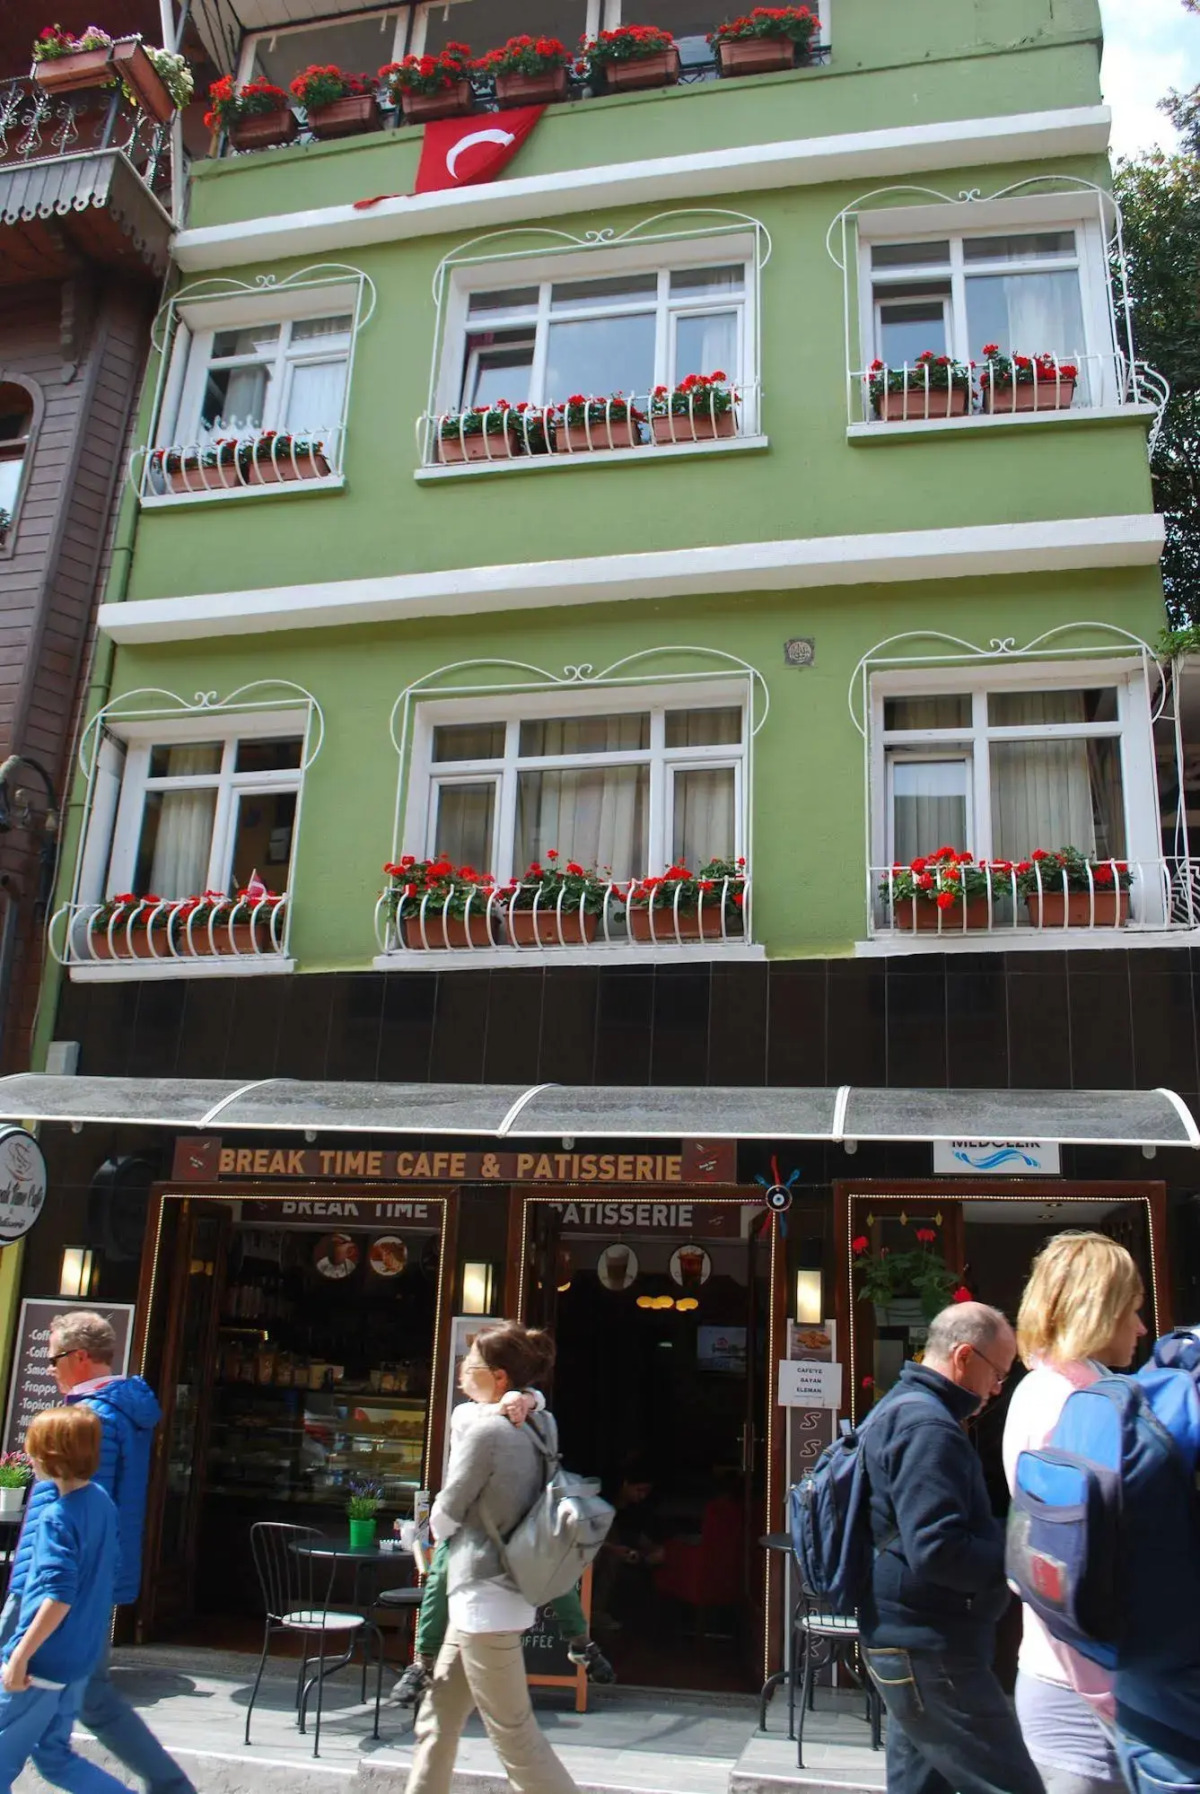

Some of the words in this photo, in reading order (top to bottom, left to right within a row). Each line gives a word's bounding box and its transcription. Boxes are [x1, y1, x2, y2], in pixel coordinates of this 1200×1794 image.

[218, 1149, 304, 1174] BREAK
[319, 1150, 382, 1176] TIME
[396, 1152, 466, 1178] CAFE
[481, 1153, 500, 1178] &
[516, 1154, 682, 1181] PATISSERIE
